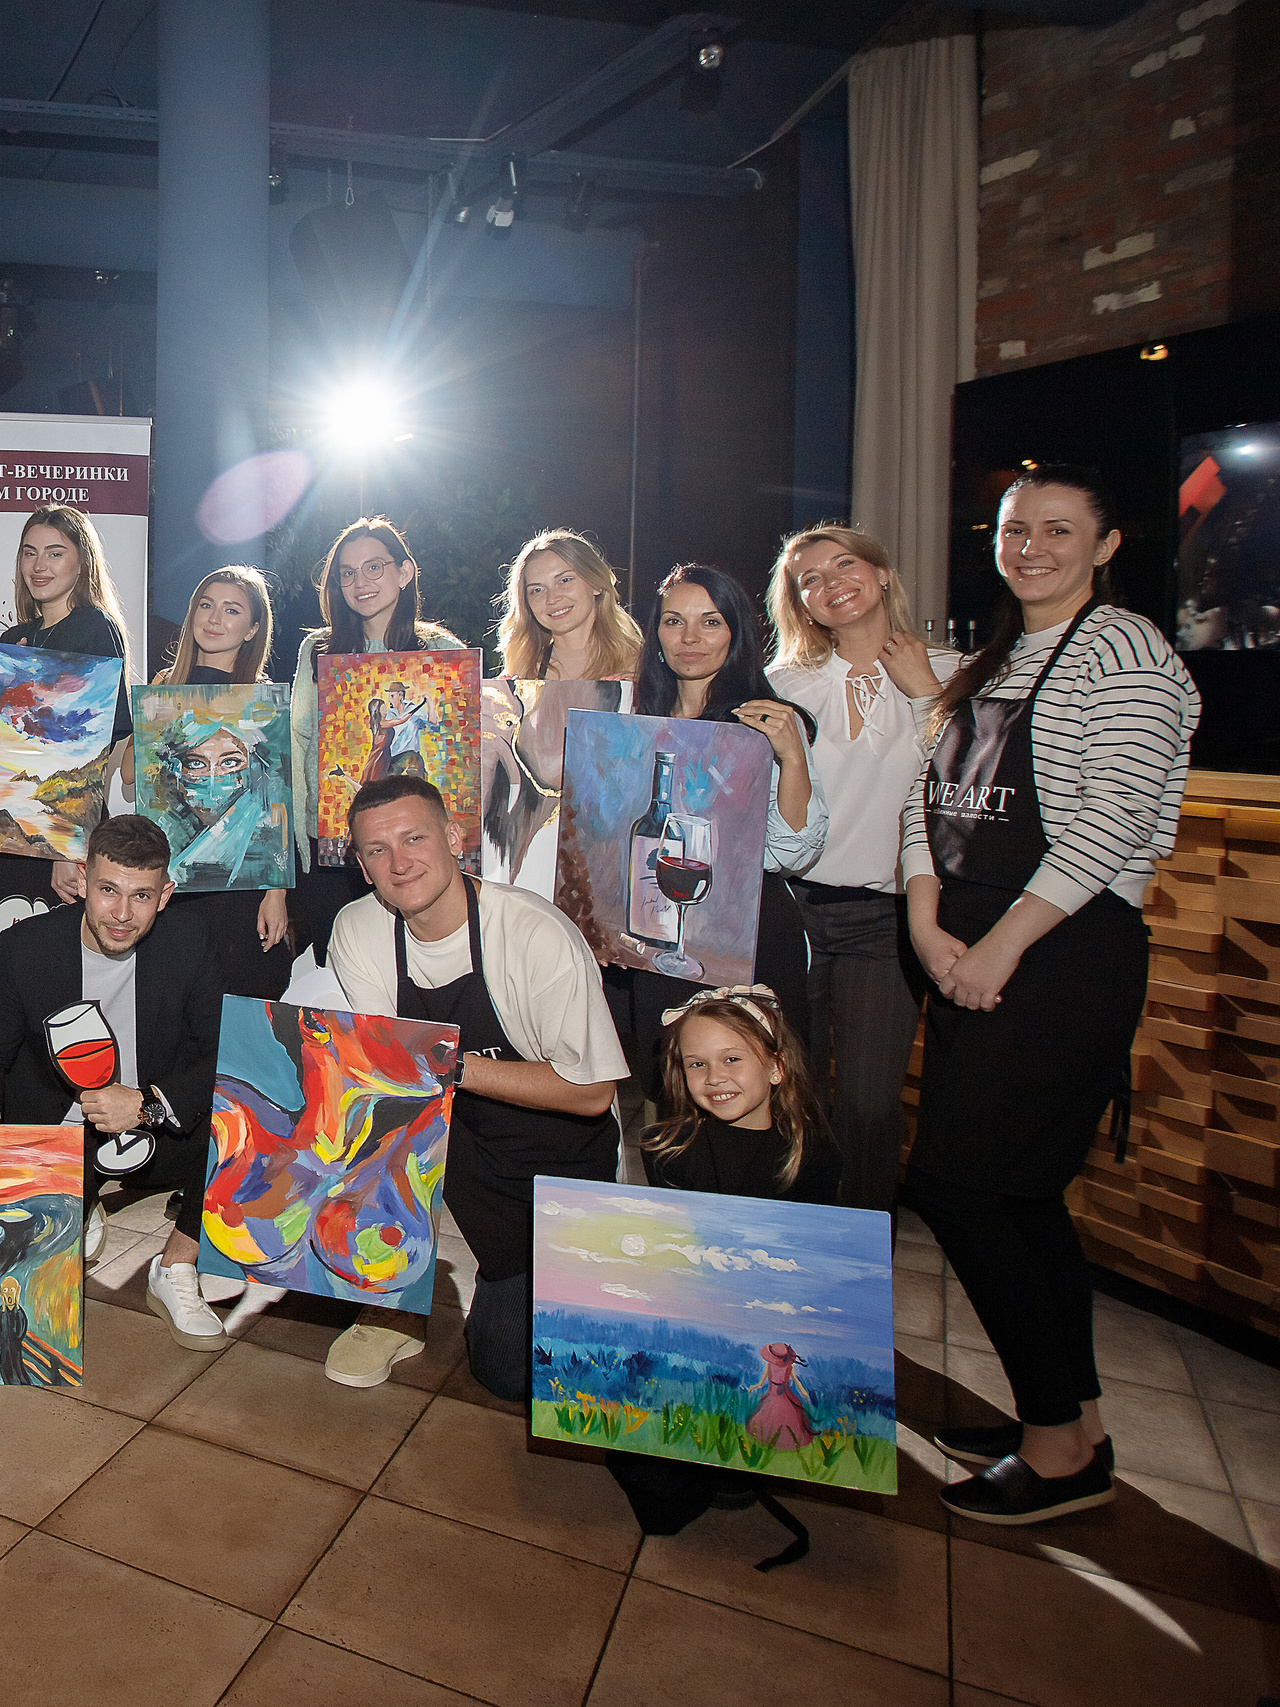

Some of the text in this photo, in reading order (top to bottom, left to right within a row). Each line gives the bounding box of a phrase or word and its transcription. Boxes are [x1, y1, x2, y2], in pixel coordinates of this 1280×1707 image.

[16, 486, 90, 504] ГОРОДЕ
[928, 781, 1015, 813] WE ART
